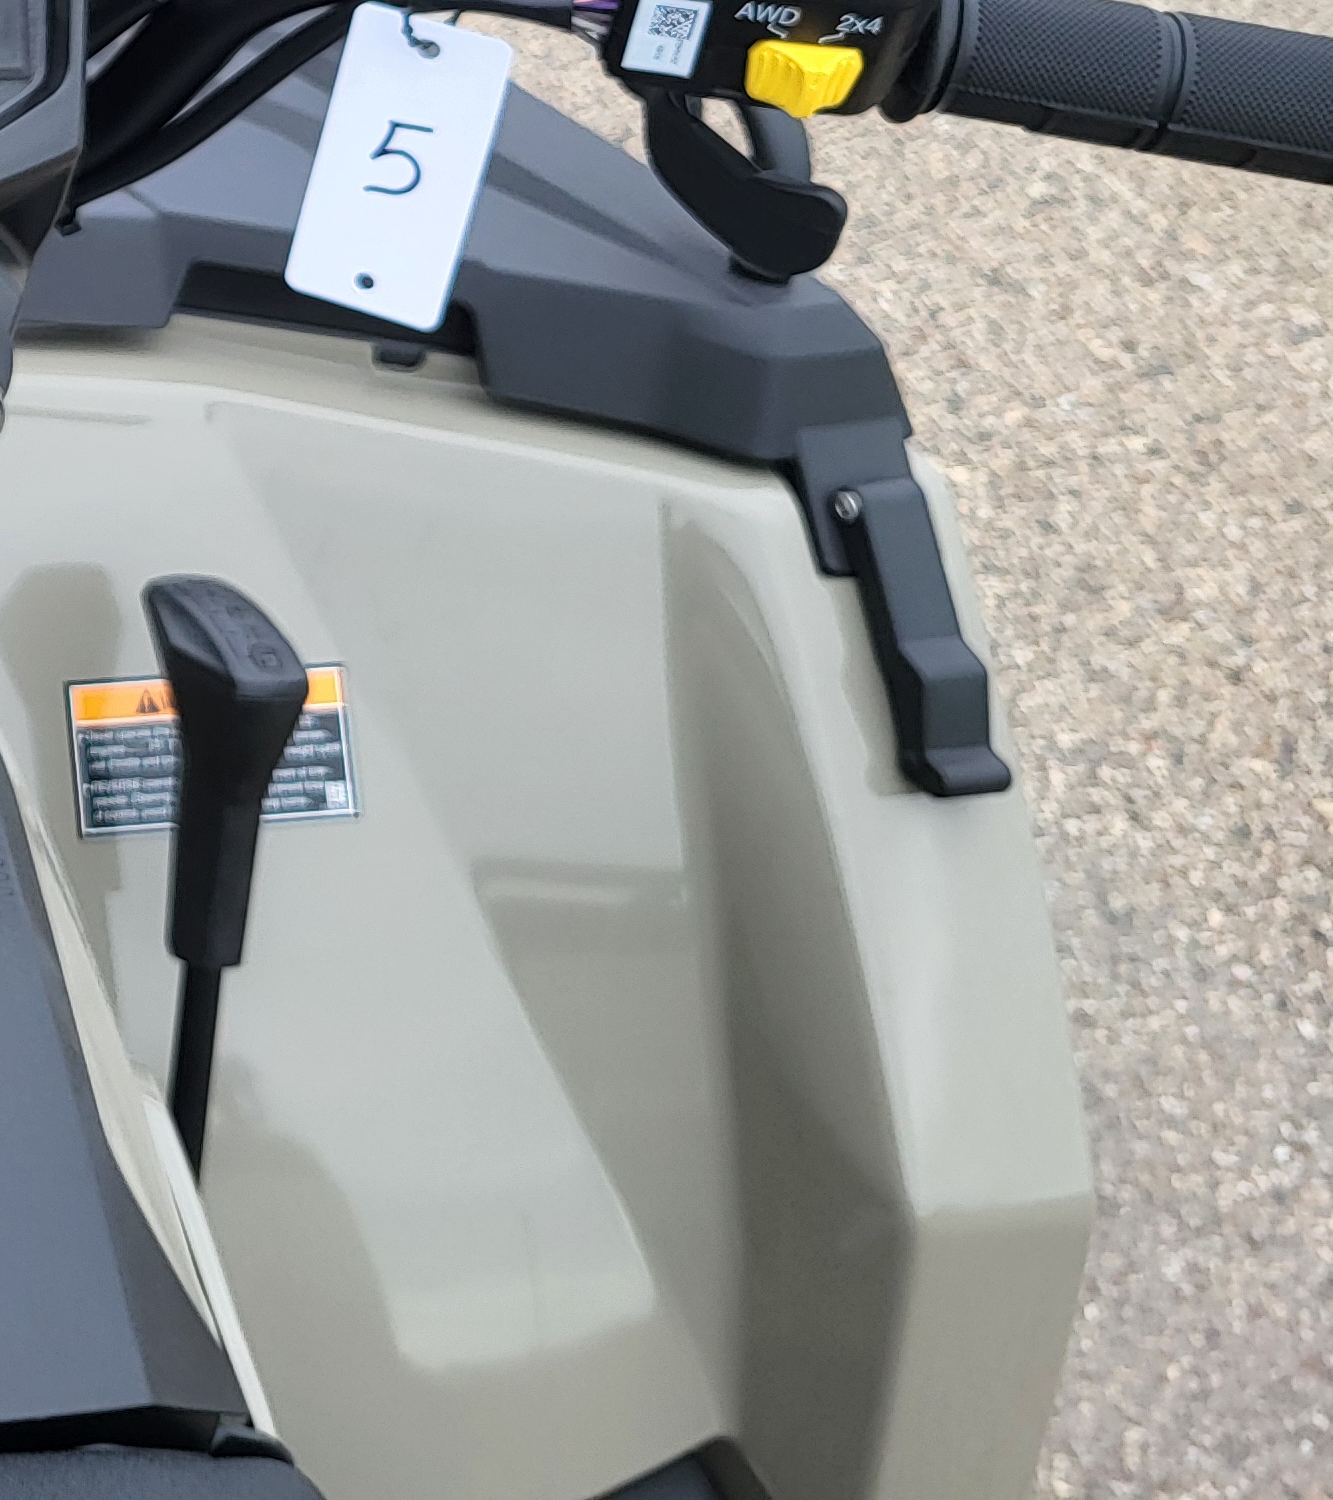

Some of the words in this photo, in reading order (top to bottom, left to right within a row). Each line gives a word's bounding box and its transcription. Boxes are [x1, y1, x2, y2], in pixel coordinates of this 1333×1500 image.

[734, 2, 802, 27] AWD
[837, 13, 884, 36] 2x4
[363, 120, 435, 196] 5
